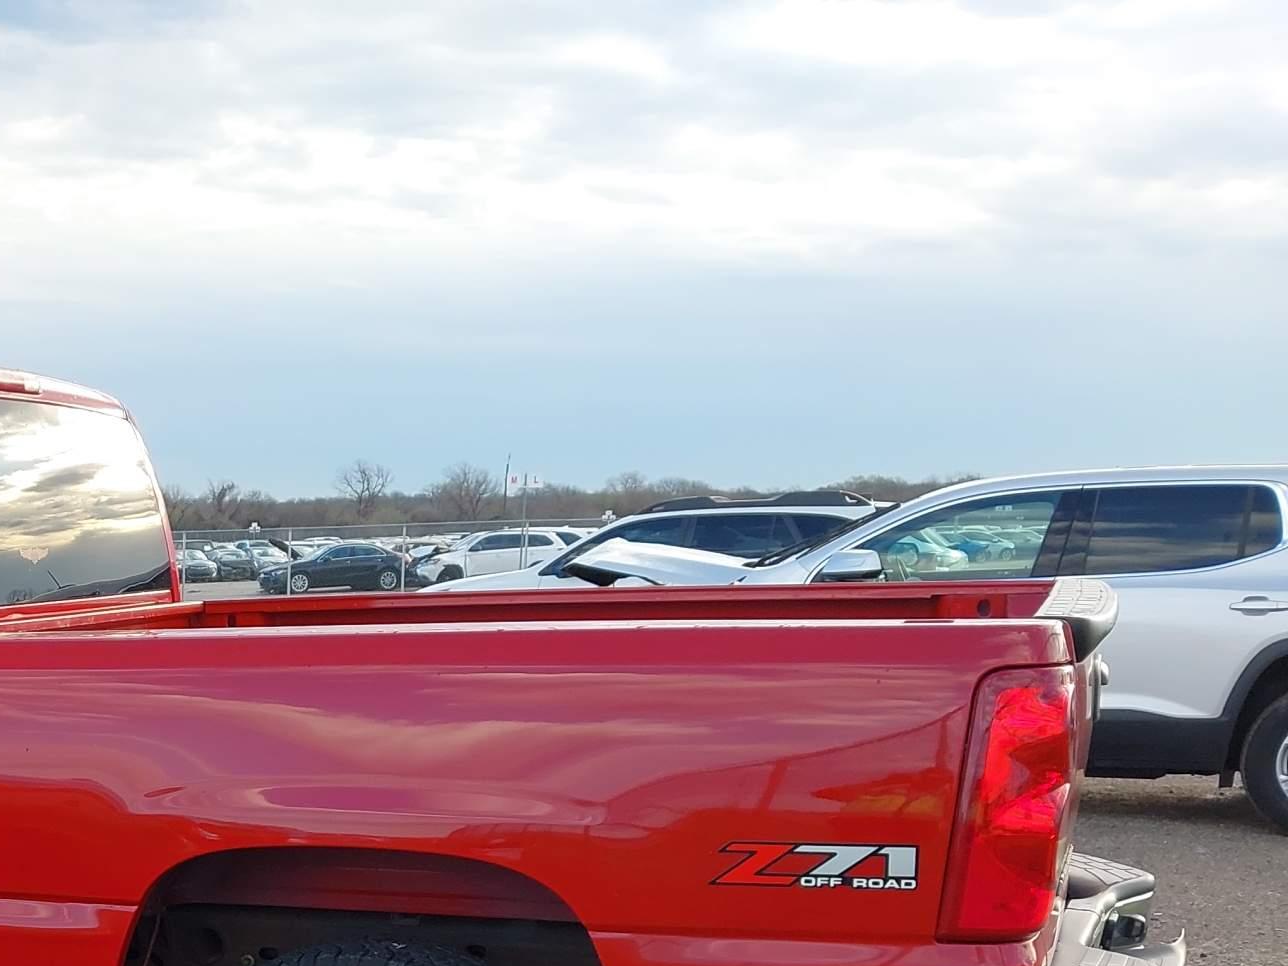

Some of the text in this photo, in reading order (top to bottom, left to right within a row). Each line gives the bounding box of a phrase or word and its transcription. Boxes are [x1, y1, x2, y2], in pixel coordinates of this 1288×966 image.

[710, 841, 919, 887] Z71
[800, 876, 917, 889] OFF ROAD
